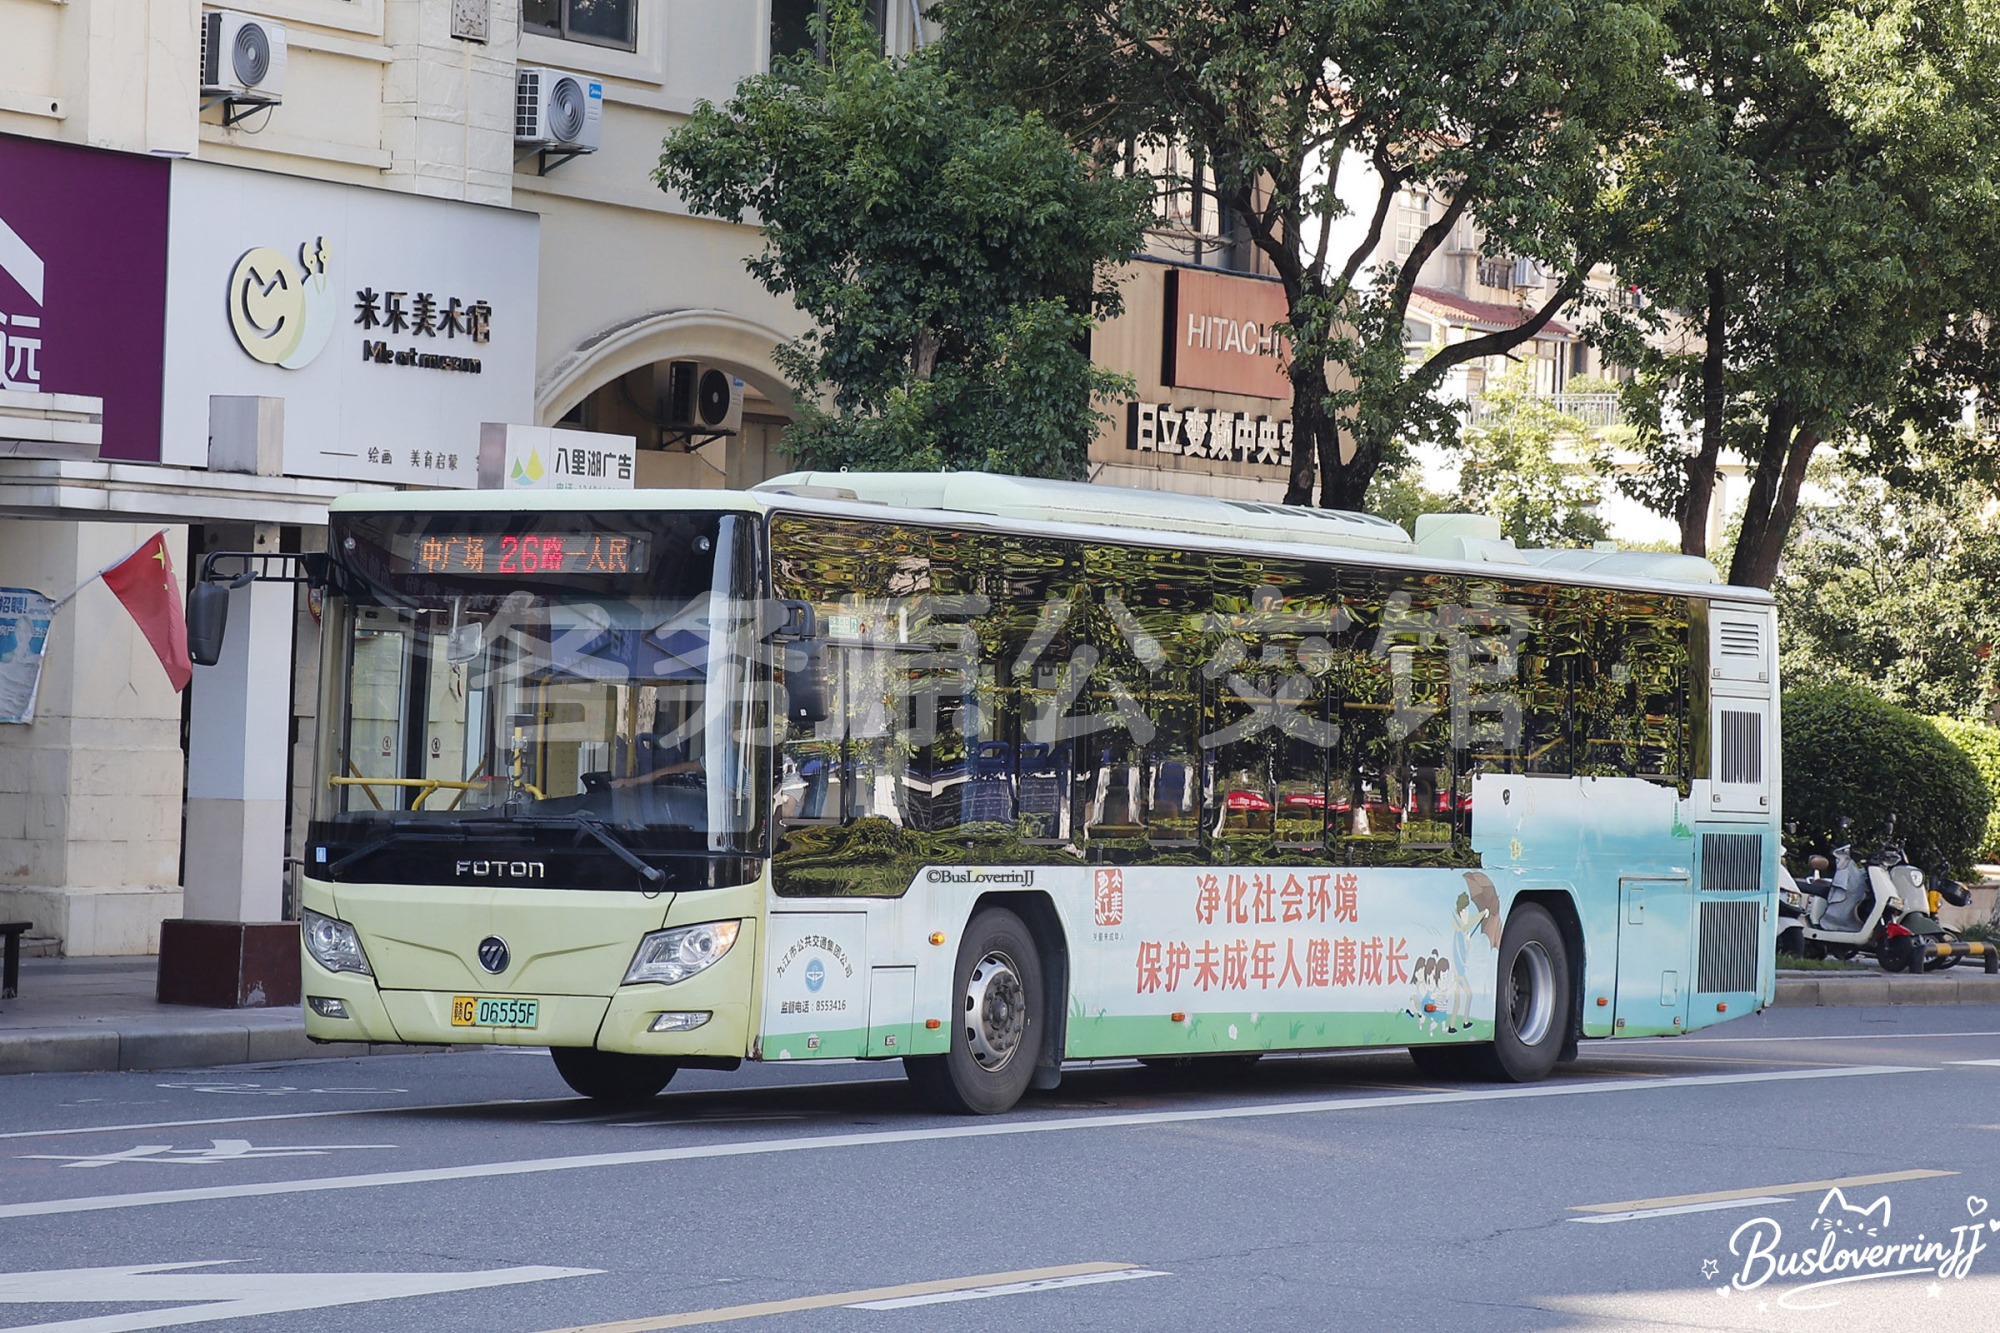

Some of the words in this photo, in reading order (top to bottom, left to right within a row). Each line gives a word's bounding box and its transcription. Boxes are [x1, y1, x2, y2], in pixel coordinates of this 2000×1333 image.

[354, 287, 492, 342] 米乐美术馆
[1186, 313, 1280, 358] HITACHI
[367, 446, 392, 464] 绘画
[410, 449, 458, 471] 美育启蒙
[555, 447, 632, 480] 八里湖广告
[456, 860, 544, 878] FOTON
[1194, 872, 1359, 925] 净化社会环境
[776, 934, 853, 979] 九江市公共交通集团公司
[1135, 936, 1409, 995] 保护未成年人健康成长
